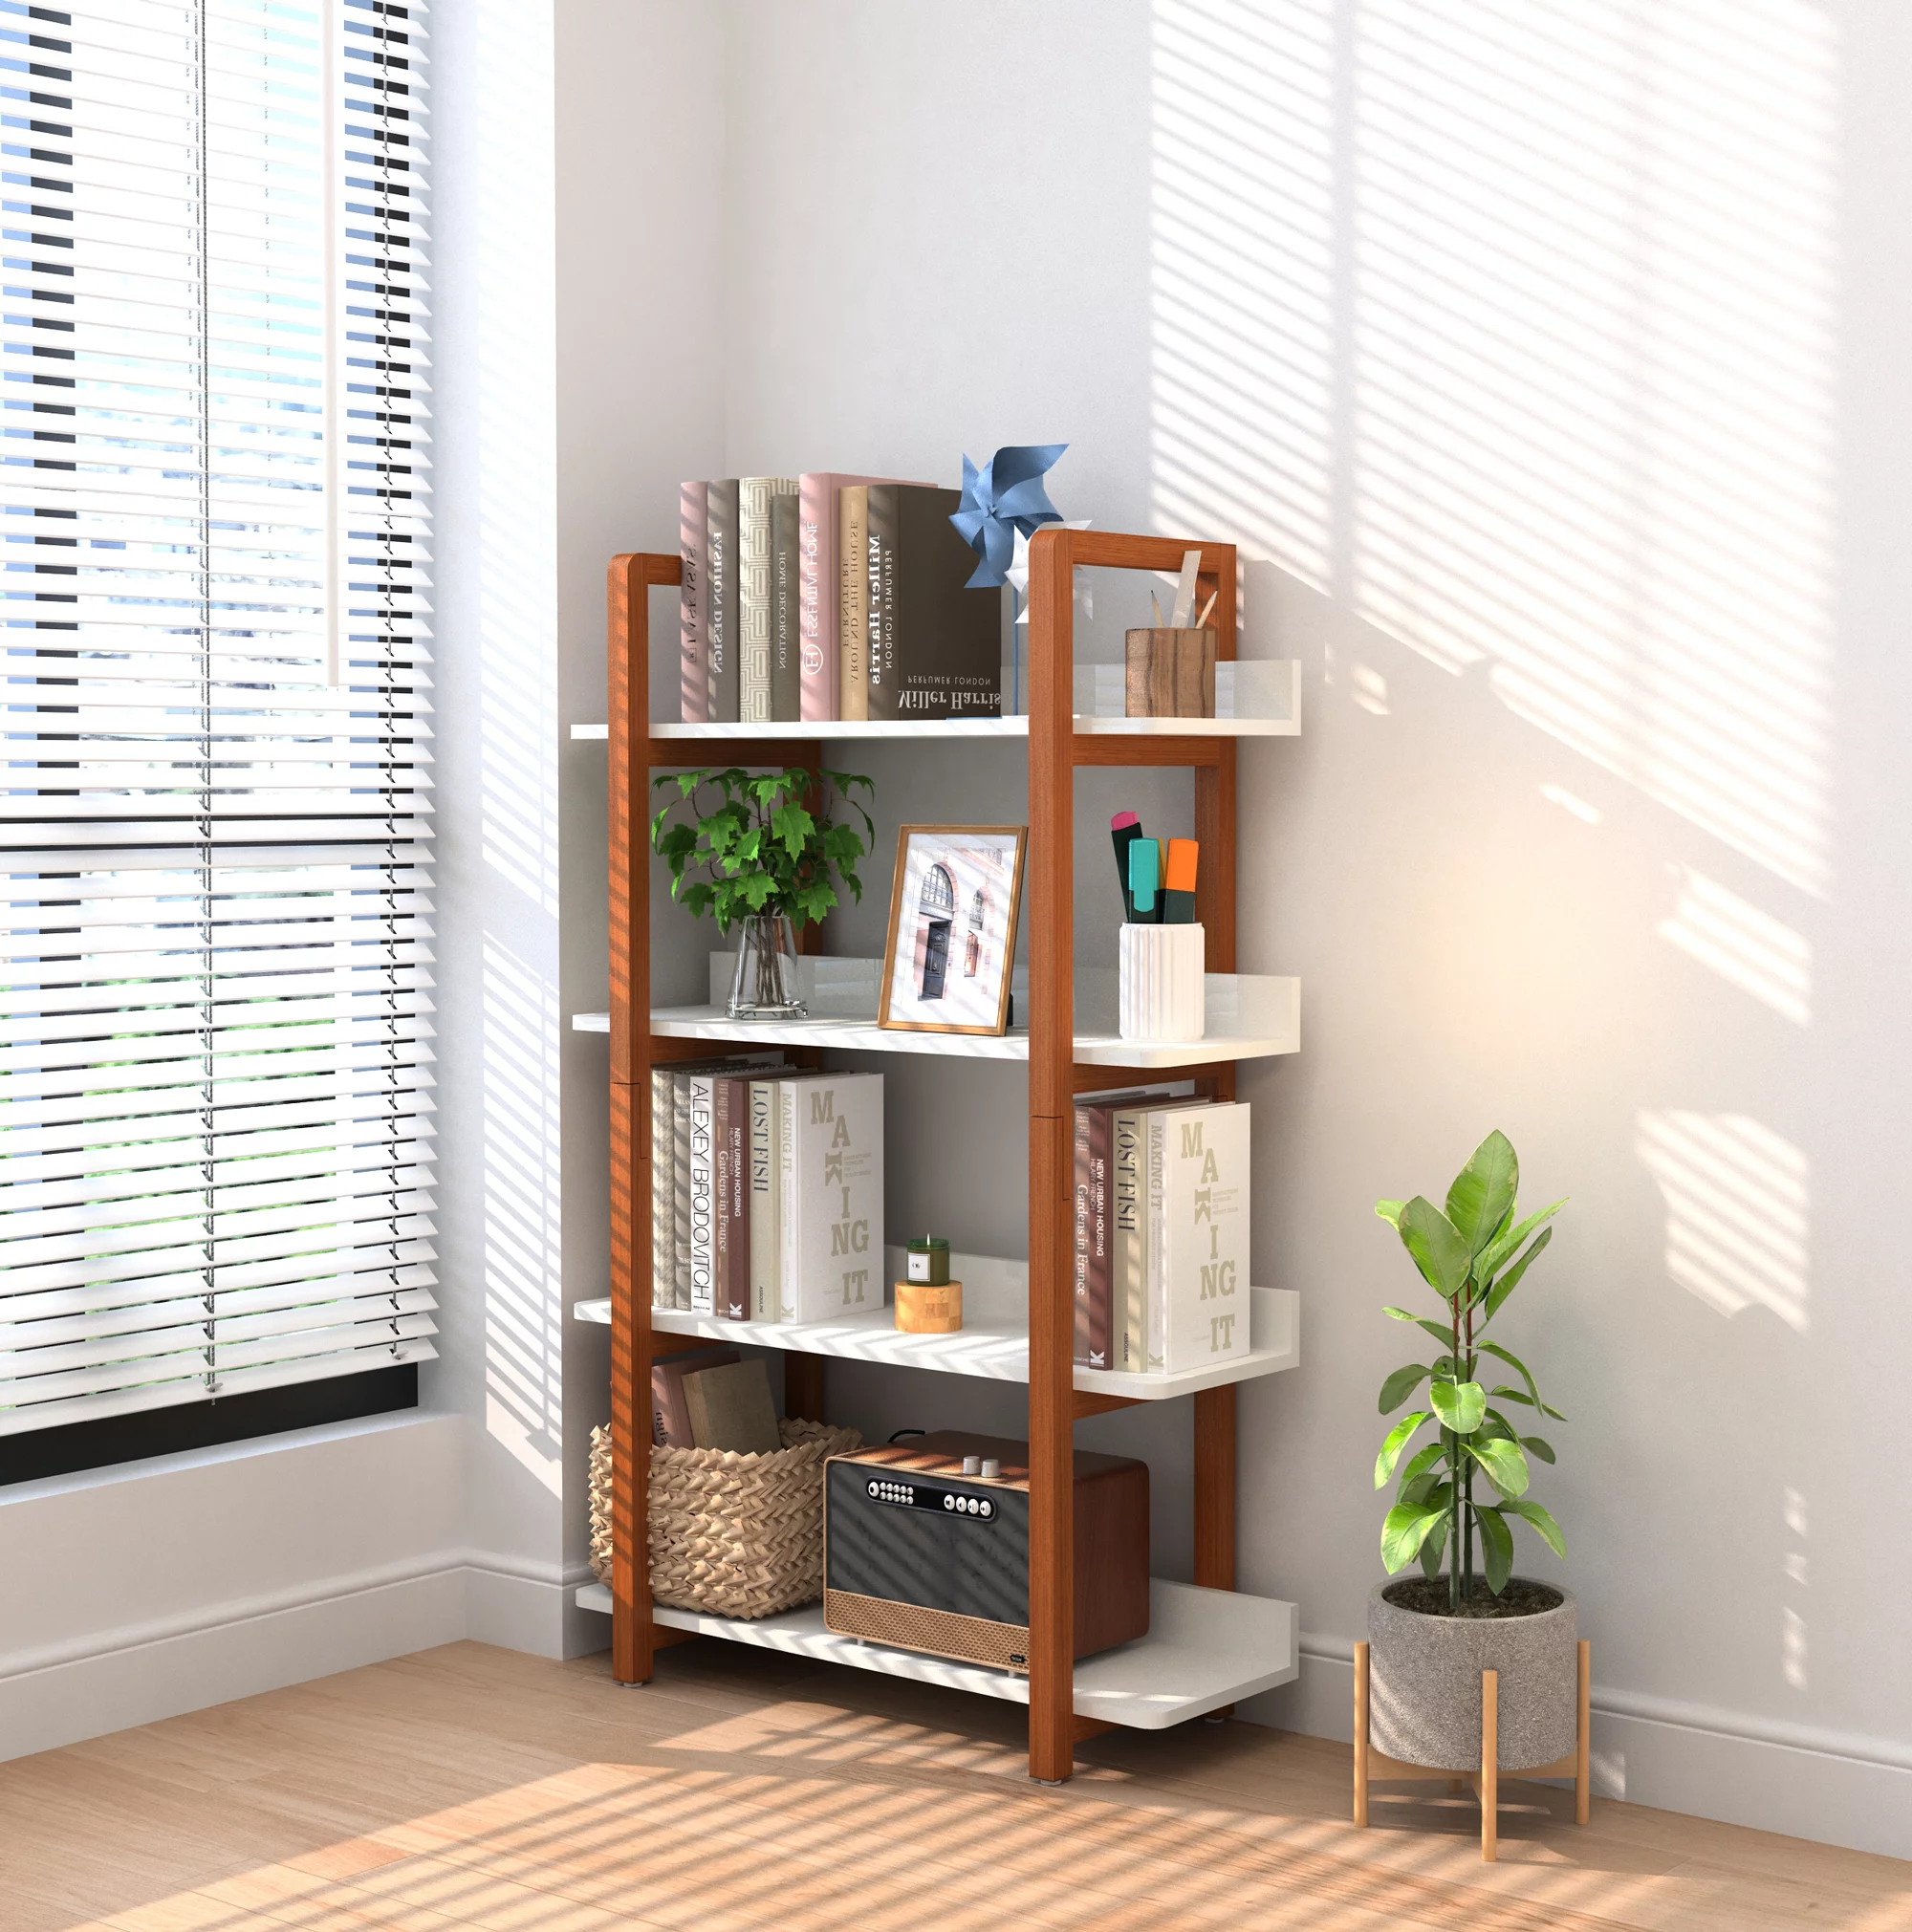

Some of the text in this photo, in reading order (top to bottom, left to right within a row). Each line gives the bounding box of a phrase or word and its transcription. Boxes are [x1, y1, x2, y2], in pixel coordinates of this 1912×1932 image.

[753, 1090, 769, 1191] LOST FISH
[782, 1094, 792, 1153] MAKING
[782, 1157, 792, 1172] IT
[1118, 1120, 1135, 1230] LOST FISH
[1151, 1125, 1162, 1189] MAKING
[693, 1083, 709, 1300] ALEXEY BRODOVITCH
[719, 1150, 728, 1252] Gardens in France
[1151, 1193, 1162, 1210] IT
[1077, 1184, 1088, 1295] Gardens in France
[842, 1270, 868, 1305] IT
[1210, 1313, 1235, 1352] IT
